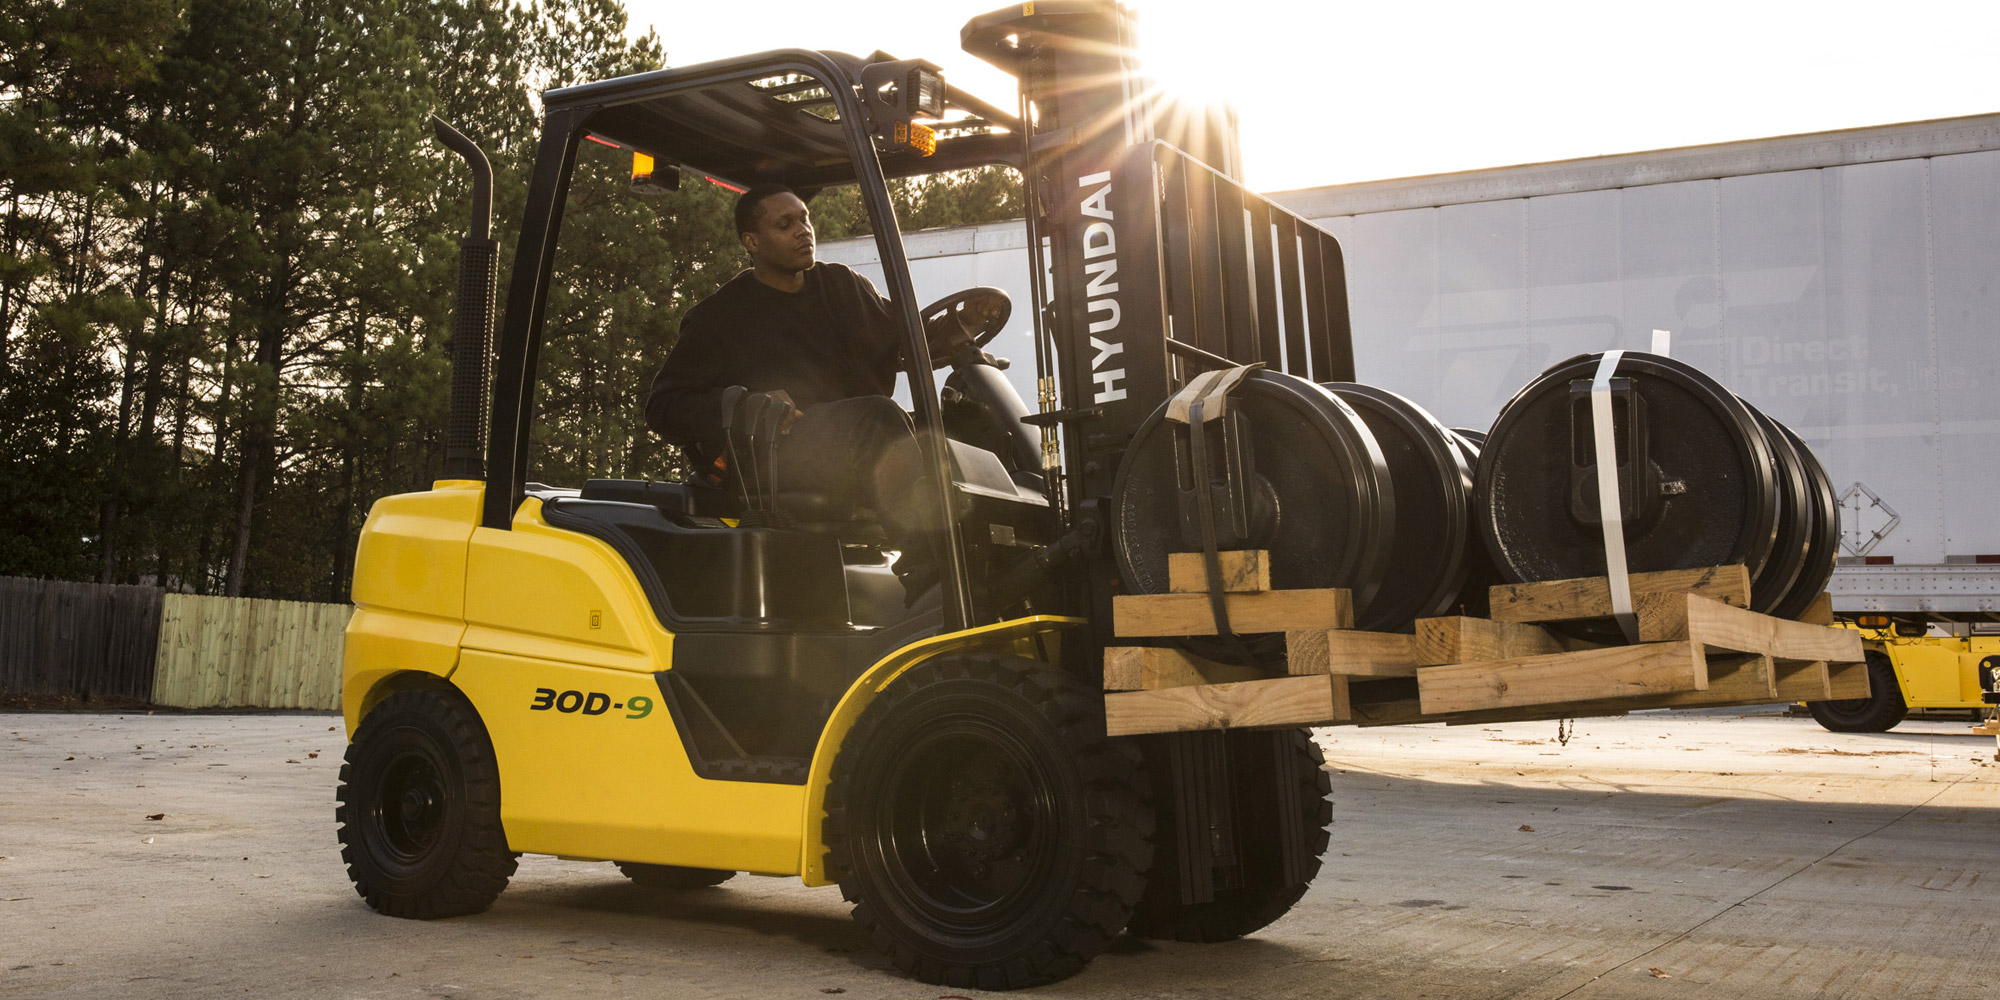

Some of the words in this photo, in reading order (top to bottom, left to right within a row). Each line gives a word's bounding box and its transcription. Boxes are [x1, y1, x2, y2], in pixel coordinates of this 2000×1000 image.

[1079, 170, 1127, 404] HYUNDAI
[1742, 334, 1869, 365] Direct
[1743, 363, 1898, 398] Transit,
[530, 688, 653, 719] 30D-9
